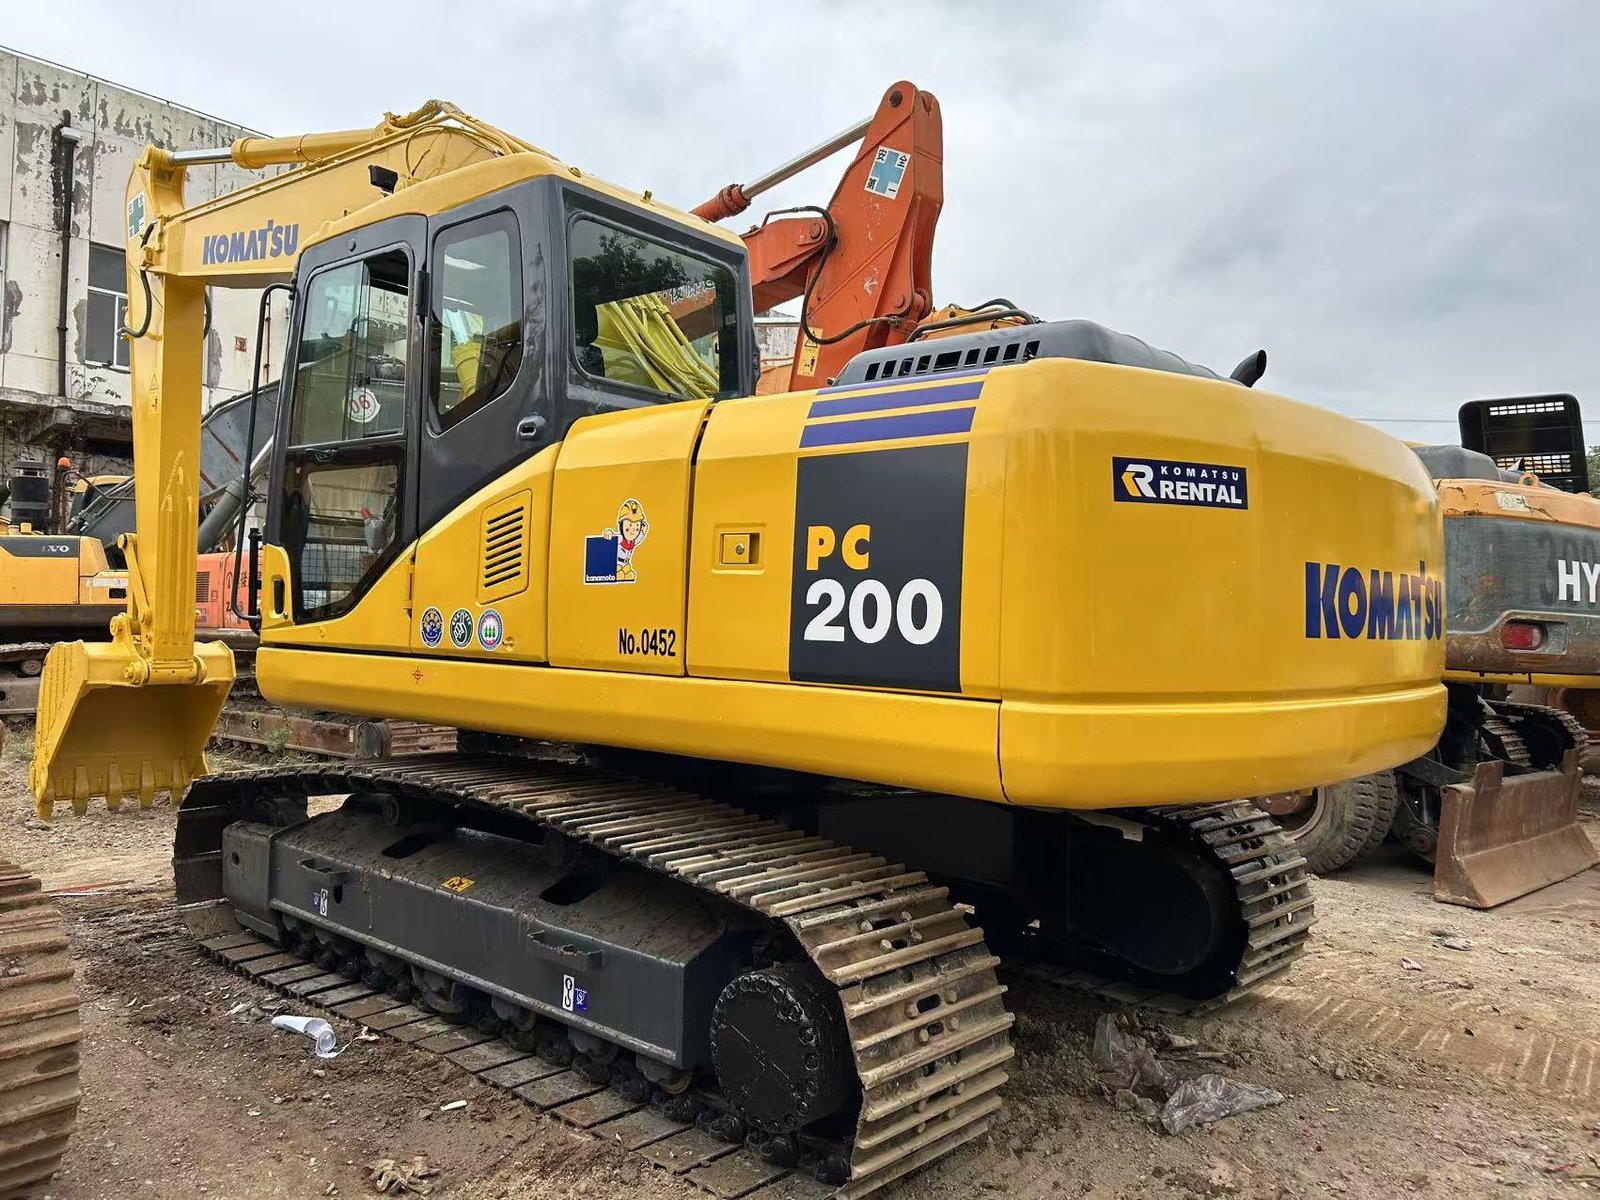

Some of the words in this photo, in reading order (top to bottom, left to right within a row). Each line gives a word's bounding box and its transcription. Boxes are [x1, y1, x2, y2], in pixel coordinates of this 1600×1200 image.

[203, 219, 299, 265] KOMATSU
[1160, 466, 1239, 481] KOMATSU
[1160, 480, 1242, 504] RENTAL
[806, 524, 871, 571] PC
[1305, 560, 1442, 640] KOMATSU
[1558, 559, 1600, 602] HY
[804, 578, 943, 645] 200
[619, 628, 676, 656] No.0452
